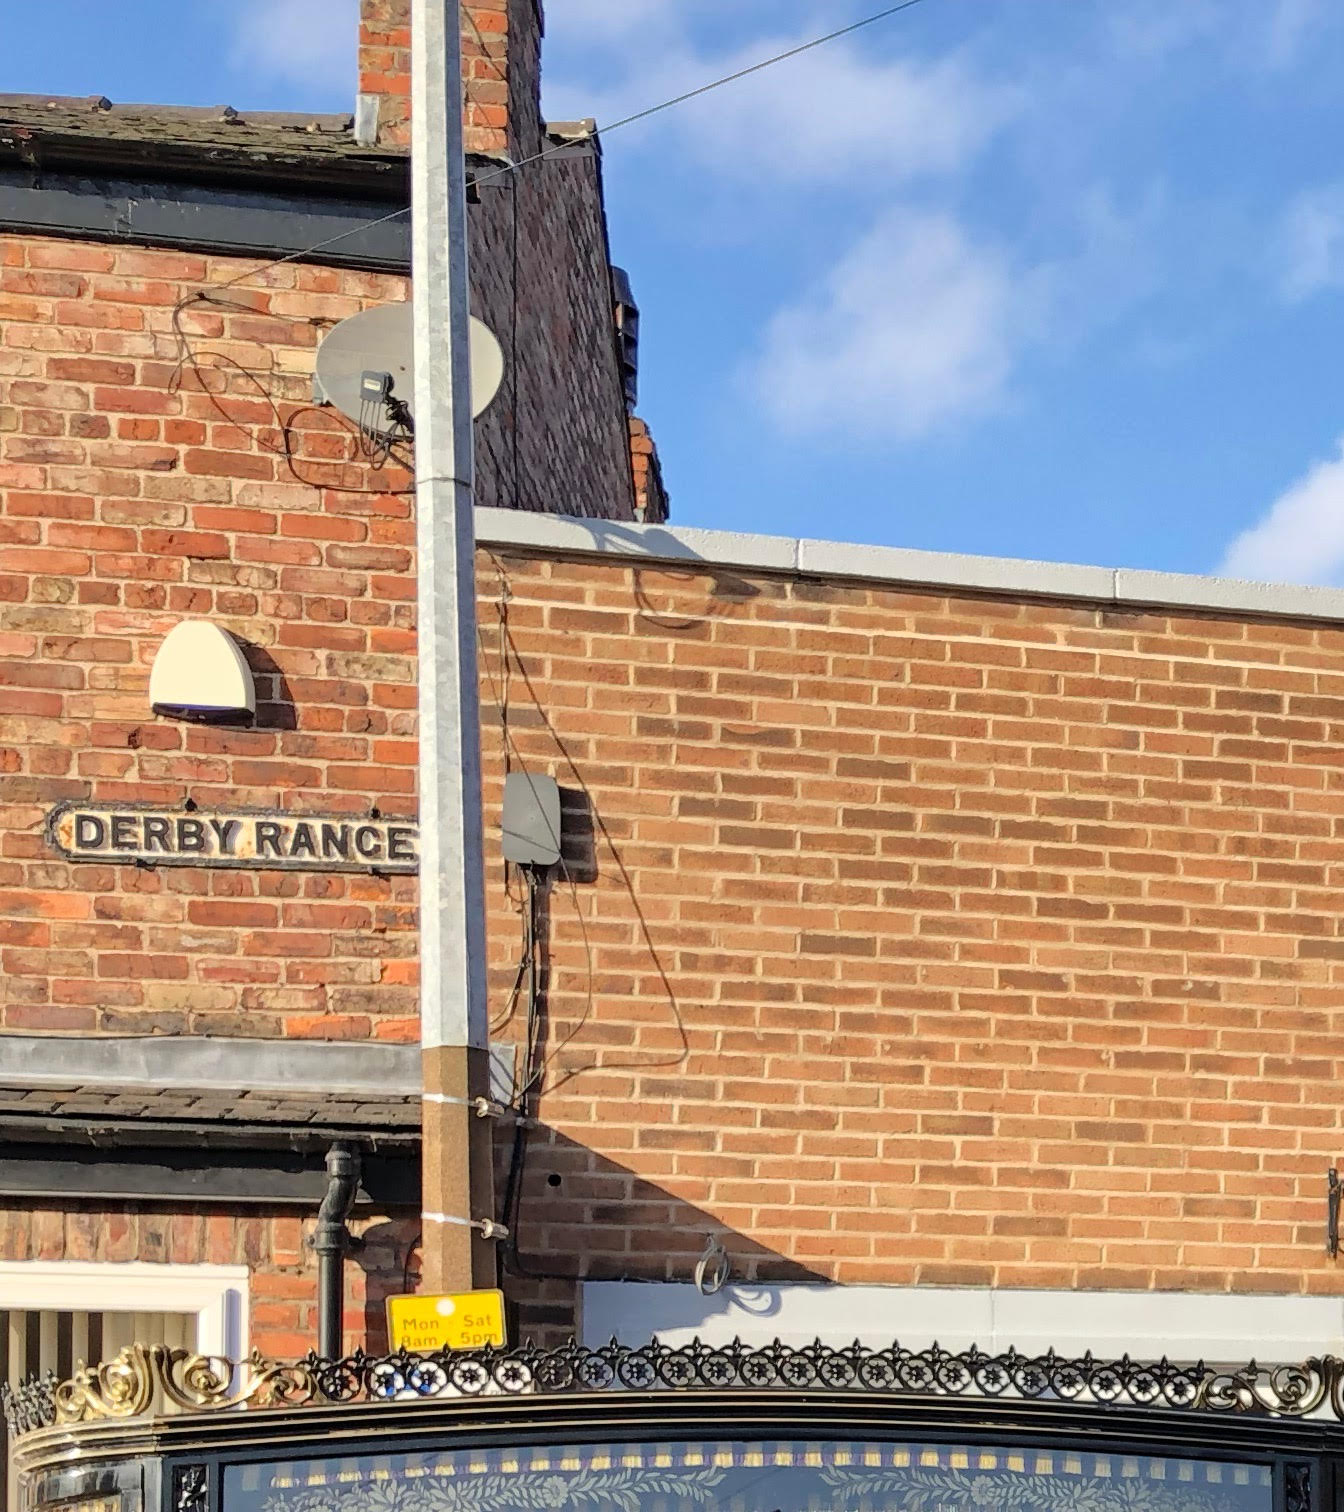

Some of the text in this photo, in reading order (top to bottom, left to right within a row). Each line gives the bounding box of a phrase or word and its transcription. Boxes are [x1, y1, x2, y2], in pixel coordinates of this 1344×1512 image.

[74, 814, 416, 860] DERBY RANGE
[402, 1318, 439, 1331] Mon
[463, 1314, 492, 1328] Sat
[460, 1332, 497, 1346] 5pm
